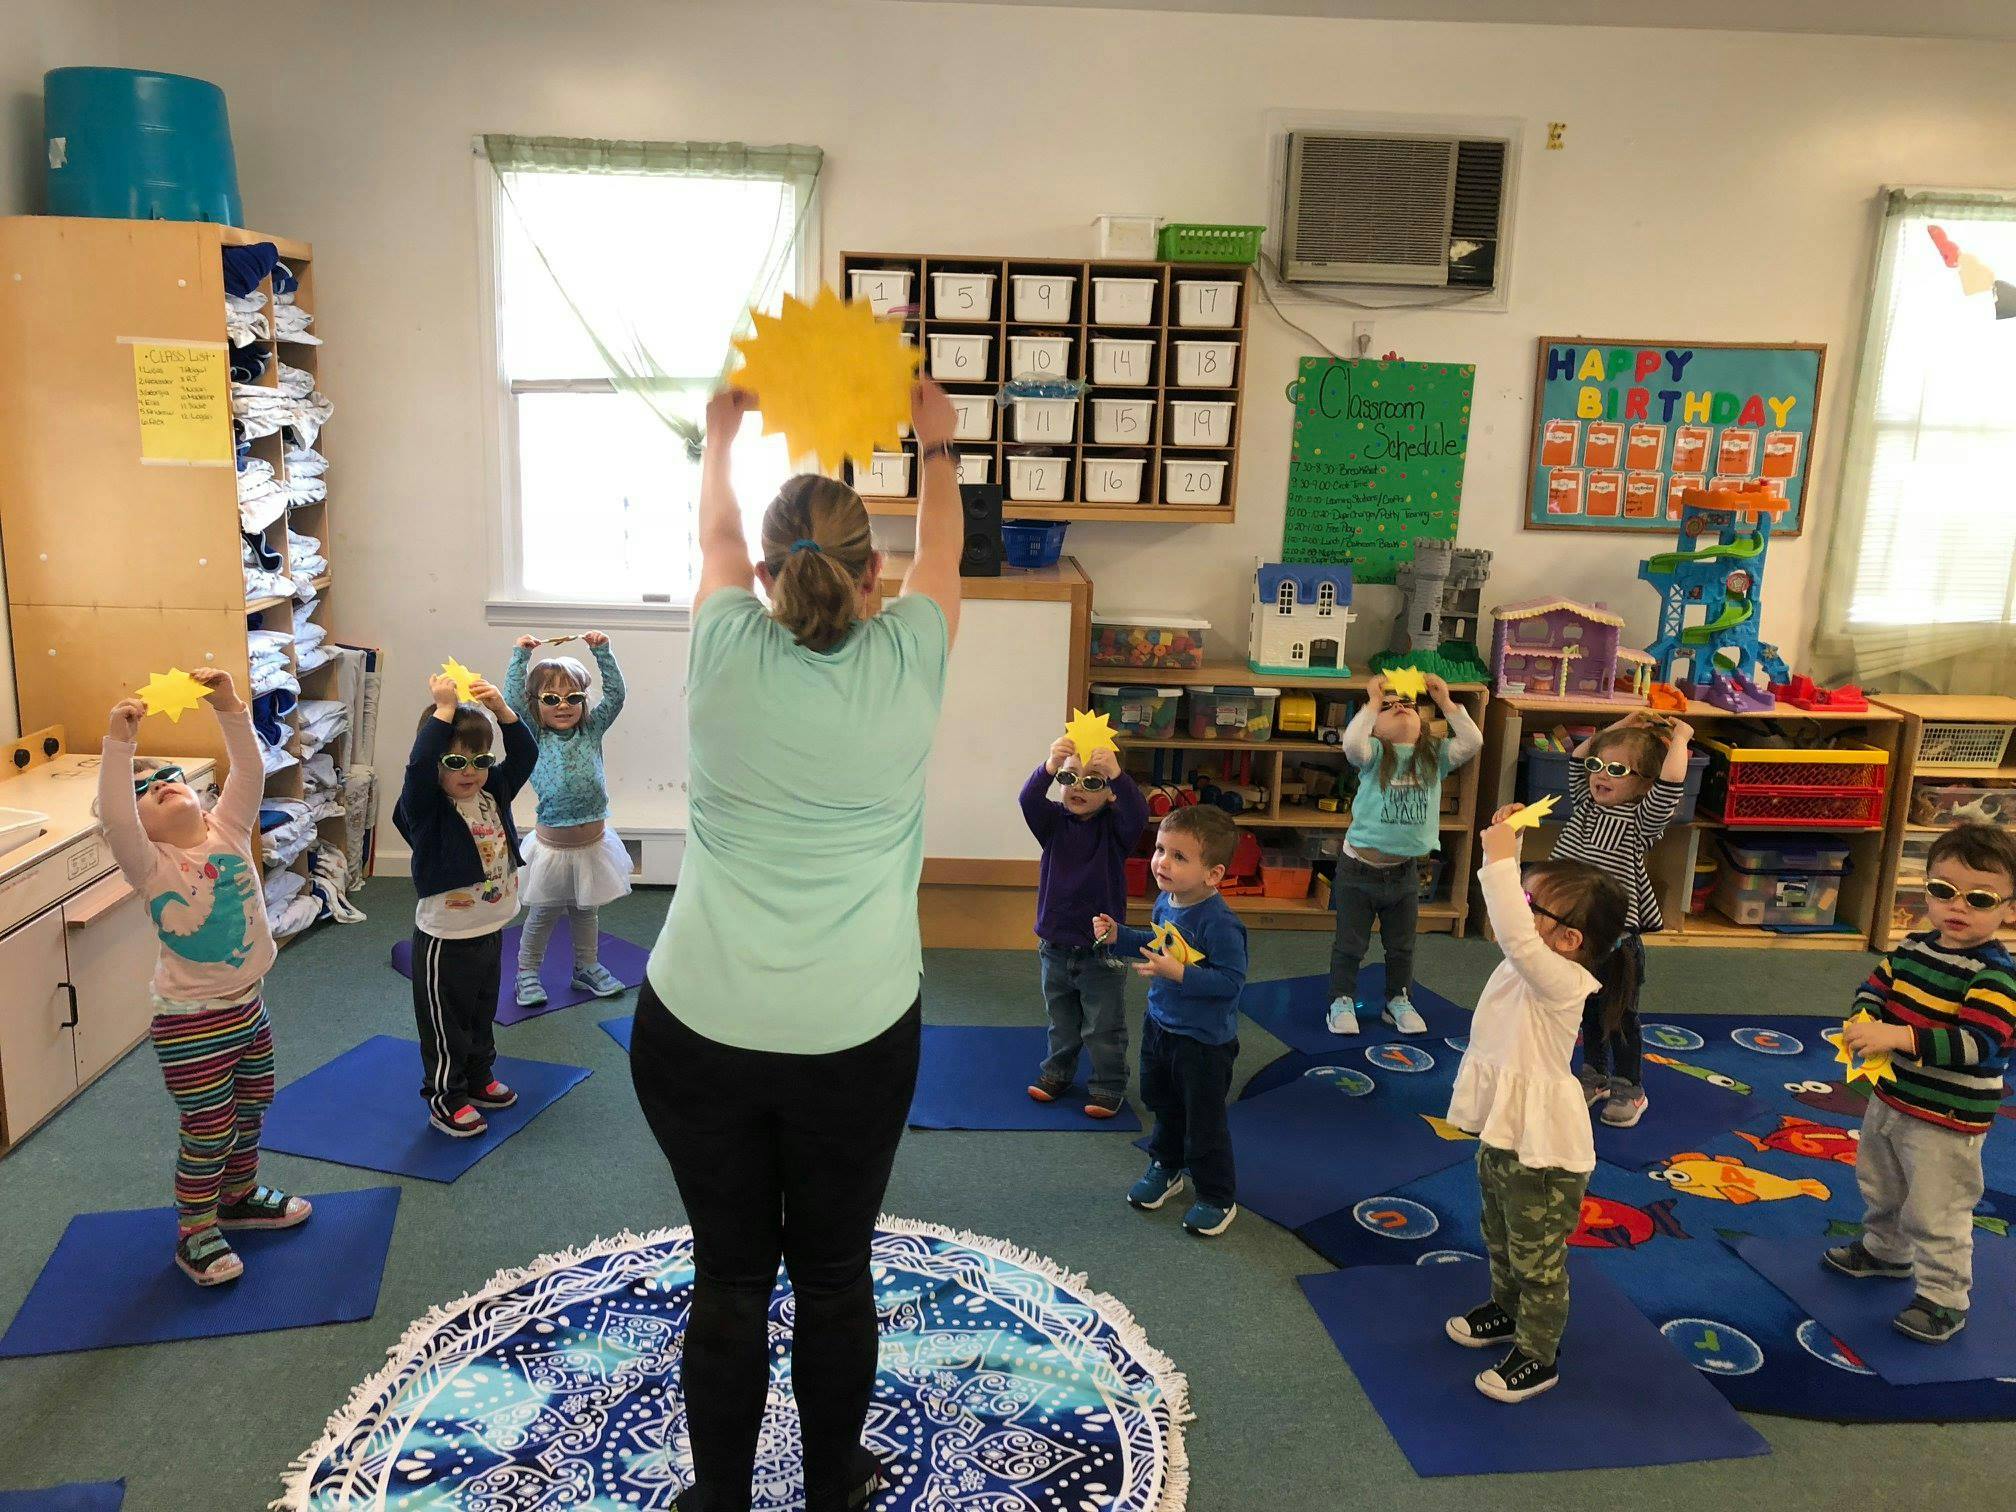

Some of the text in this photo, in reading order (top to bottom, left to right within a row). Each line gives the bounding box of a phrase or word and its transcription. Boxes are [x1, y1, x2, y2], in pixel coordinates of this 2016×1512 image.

[873, 282, 889, 302] 1
[958, 286, 974, 309] 5
[1038, 284, 1051, 310] 9
[1199, 288, 1218, 314] 17
[954, 346, 968, 368] 6
[1032, 349, 1051, 371] 10
[1113, 350, 1132, 377] 14
[1197, 350, 1217, 376] 18
[1548, 348, 1694, 383] HAPPY
[1319, 365, 1425, 421] Classroom
[956, 407, 969, 430] 7
[1576, 385, 1797, 428] BIRTHDAY
[1036, 411, 1050, 432] 11
[1115, 408, 1138, 433] 15
[1193, 409, 1212, 436] 19
[1364, 422, 1461, 462] Schedule
[871, 462, 884, 488] 4
[1028, 469, 1046, 492] 12
[1103, 470, 1123, 492] 16
[1184, 473, 1212, 492] 20
